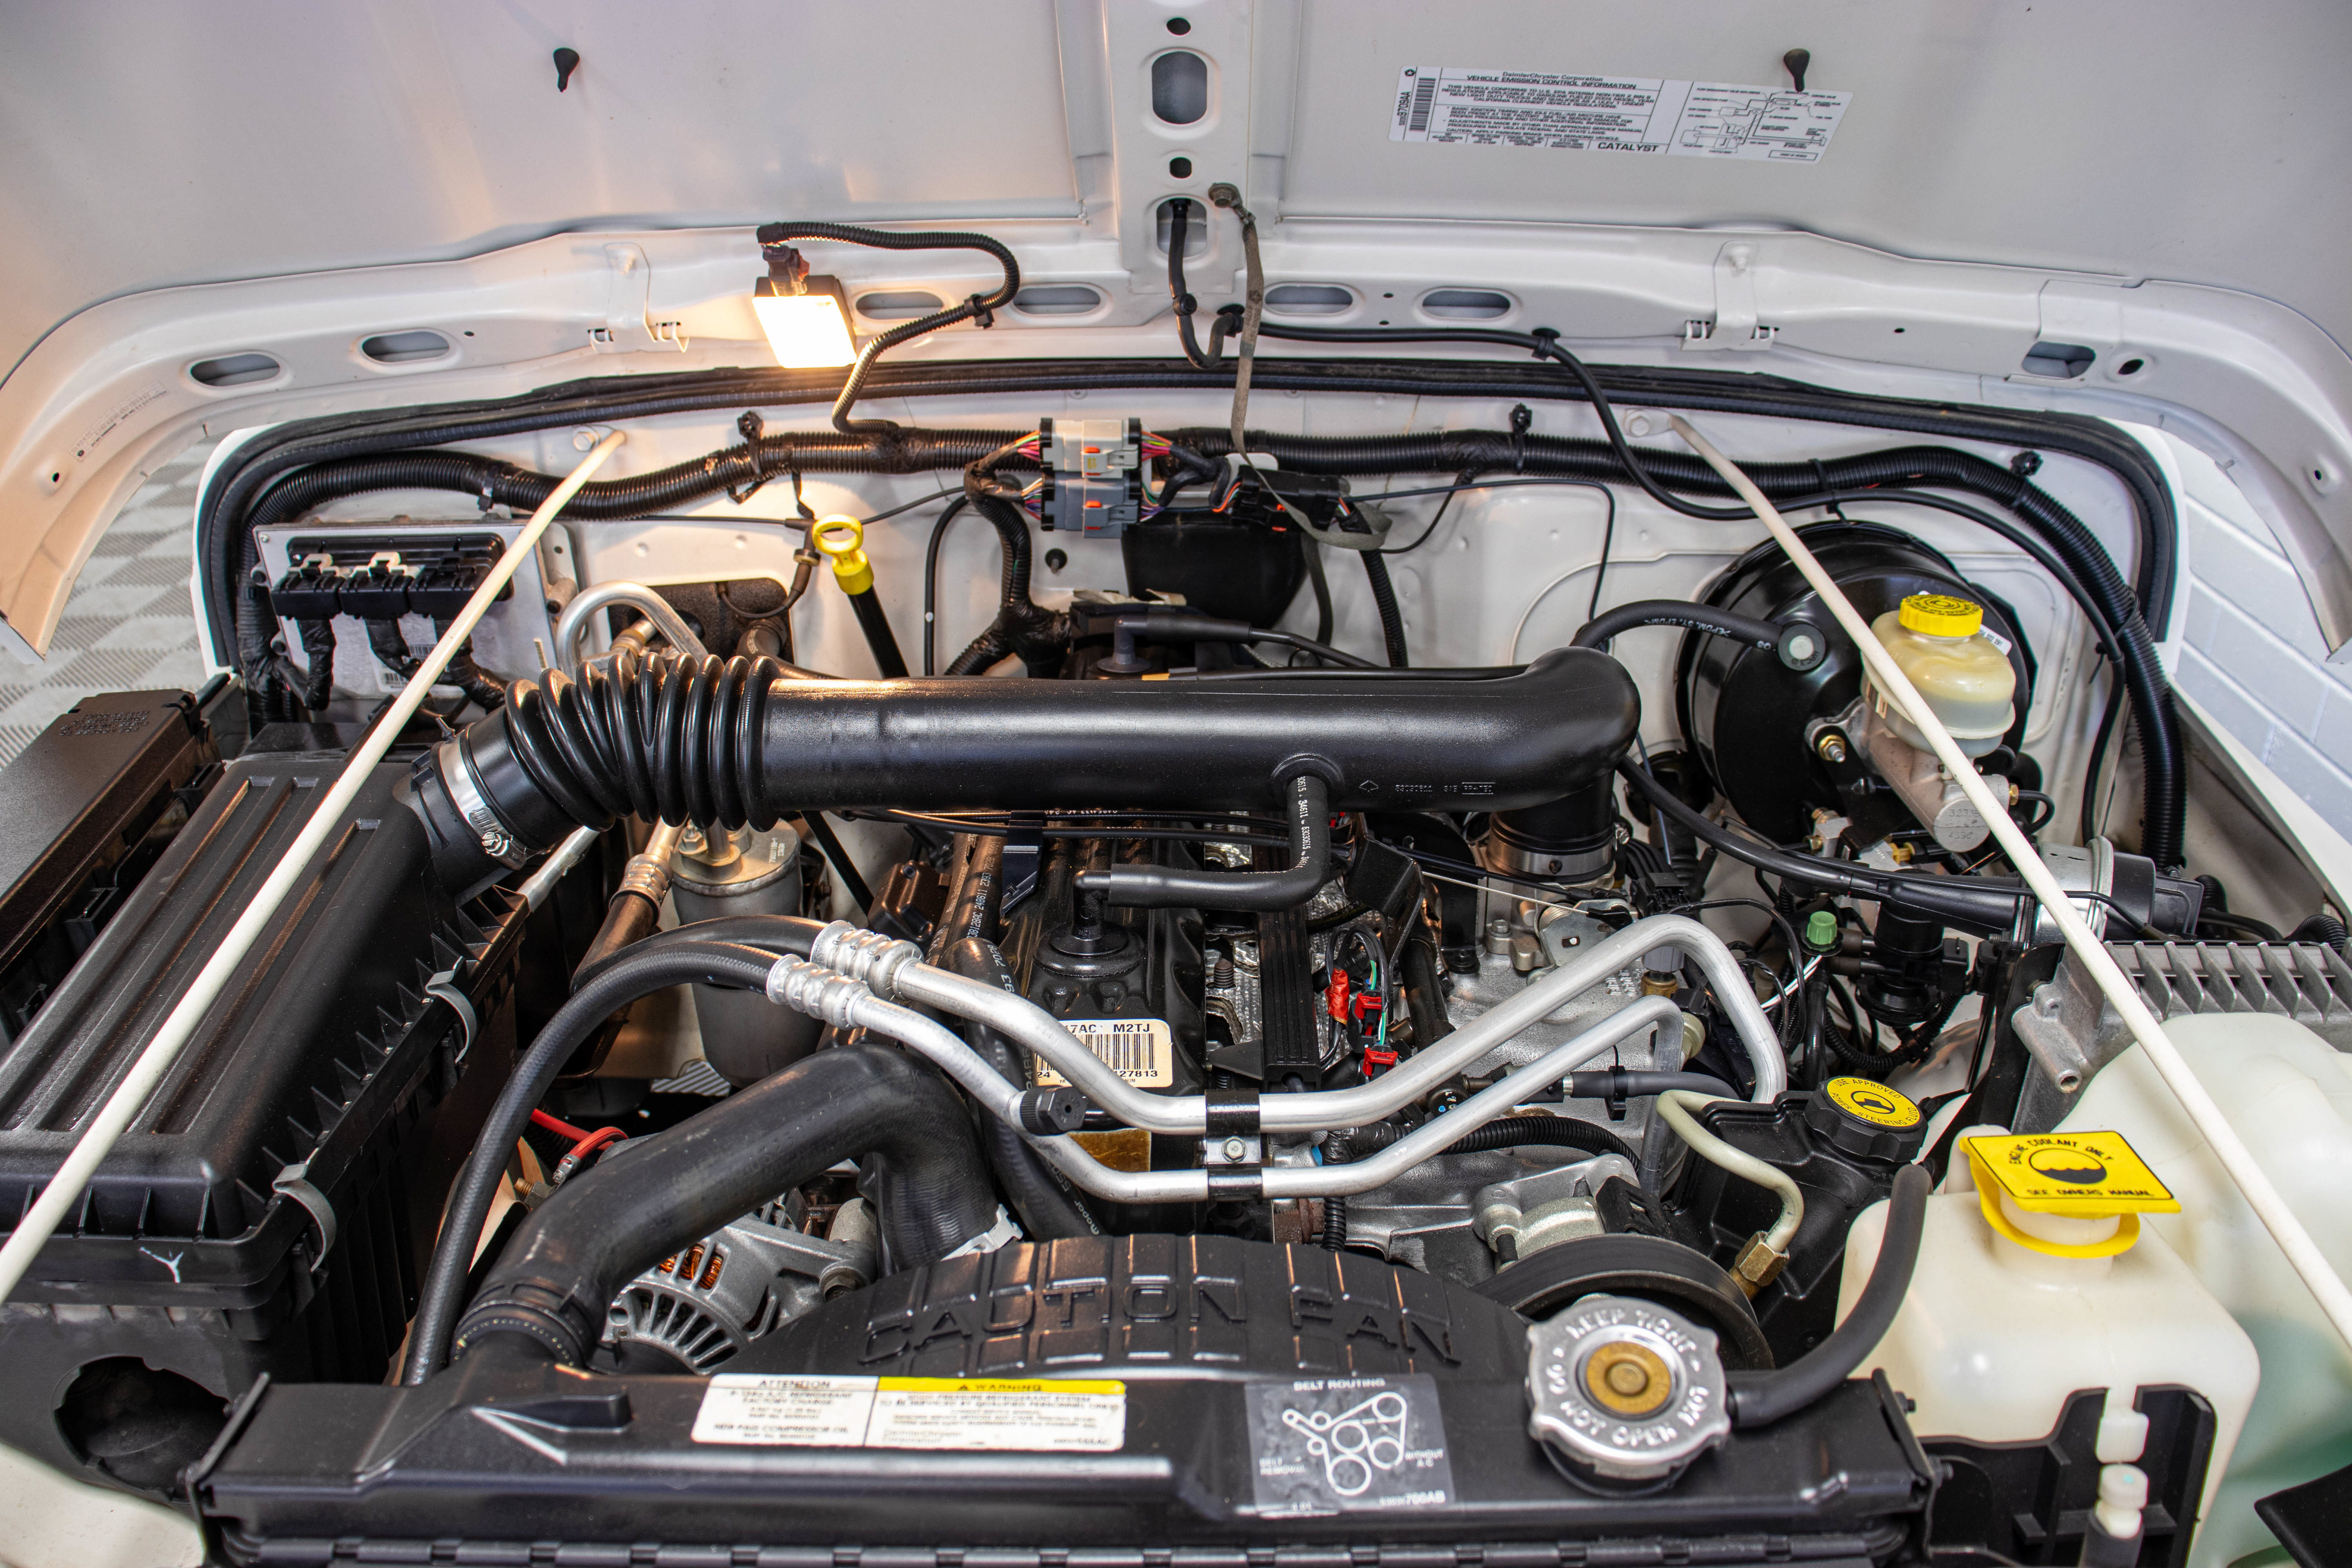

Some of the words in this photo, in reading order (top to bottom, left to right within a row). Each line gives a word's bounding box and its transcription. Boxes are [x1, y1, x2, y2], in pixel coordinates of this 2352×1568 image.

[1502, 71, 1560, 80] DaimlerChrysler
[1598, 142, 1658, 151] CATALYST
[1298, 800, 1308, 818] 34611
[987, 944, 1006, 967] 7028
[1114, 1024, 1149, 1032] M2TJ
[1852, 1079, 1901, 1098] APPROVED
[1830, 1092, 1852, 1110] POWER
[1858, 1112, 1907, 1125] STEERING
[1906, 1107, 1917, 1123] FLUID
[2009, 1144, 2028, 1164] ENGINE
[2027, 1139, 2078, 1147] COOLANT
[2085, 1146, 2114, 1160] ONLY
[858, 1281, 1247, 1365] CAUTION
[1291, 1284, 1461, 1365] FAN
[1566, 1309, 1626, 1339] KEEP
[1636, 1309, 1696, 1353] TIGHT
[759, 1380, 831, 1389] ATTENTION
[1294, 1381, 1325, 1391] BELT
[1328, 1378, 1385, 1390] ROUTING
[1560, 1401, 1606, 1436] NOT
[1612, 1423, 1677, 1447] OPEN
[1405, 1449, 1444, 1460] WITHOUT
[1260, 1465, 1305, 1476] REMOVAL
